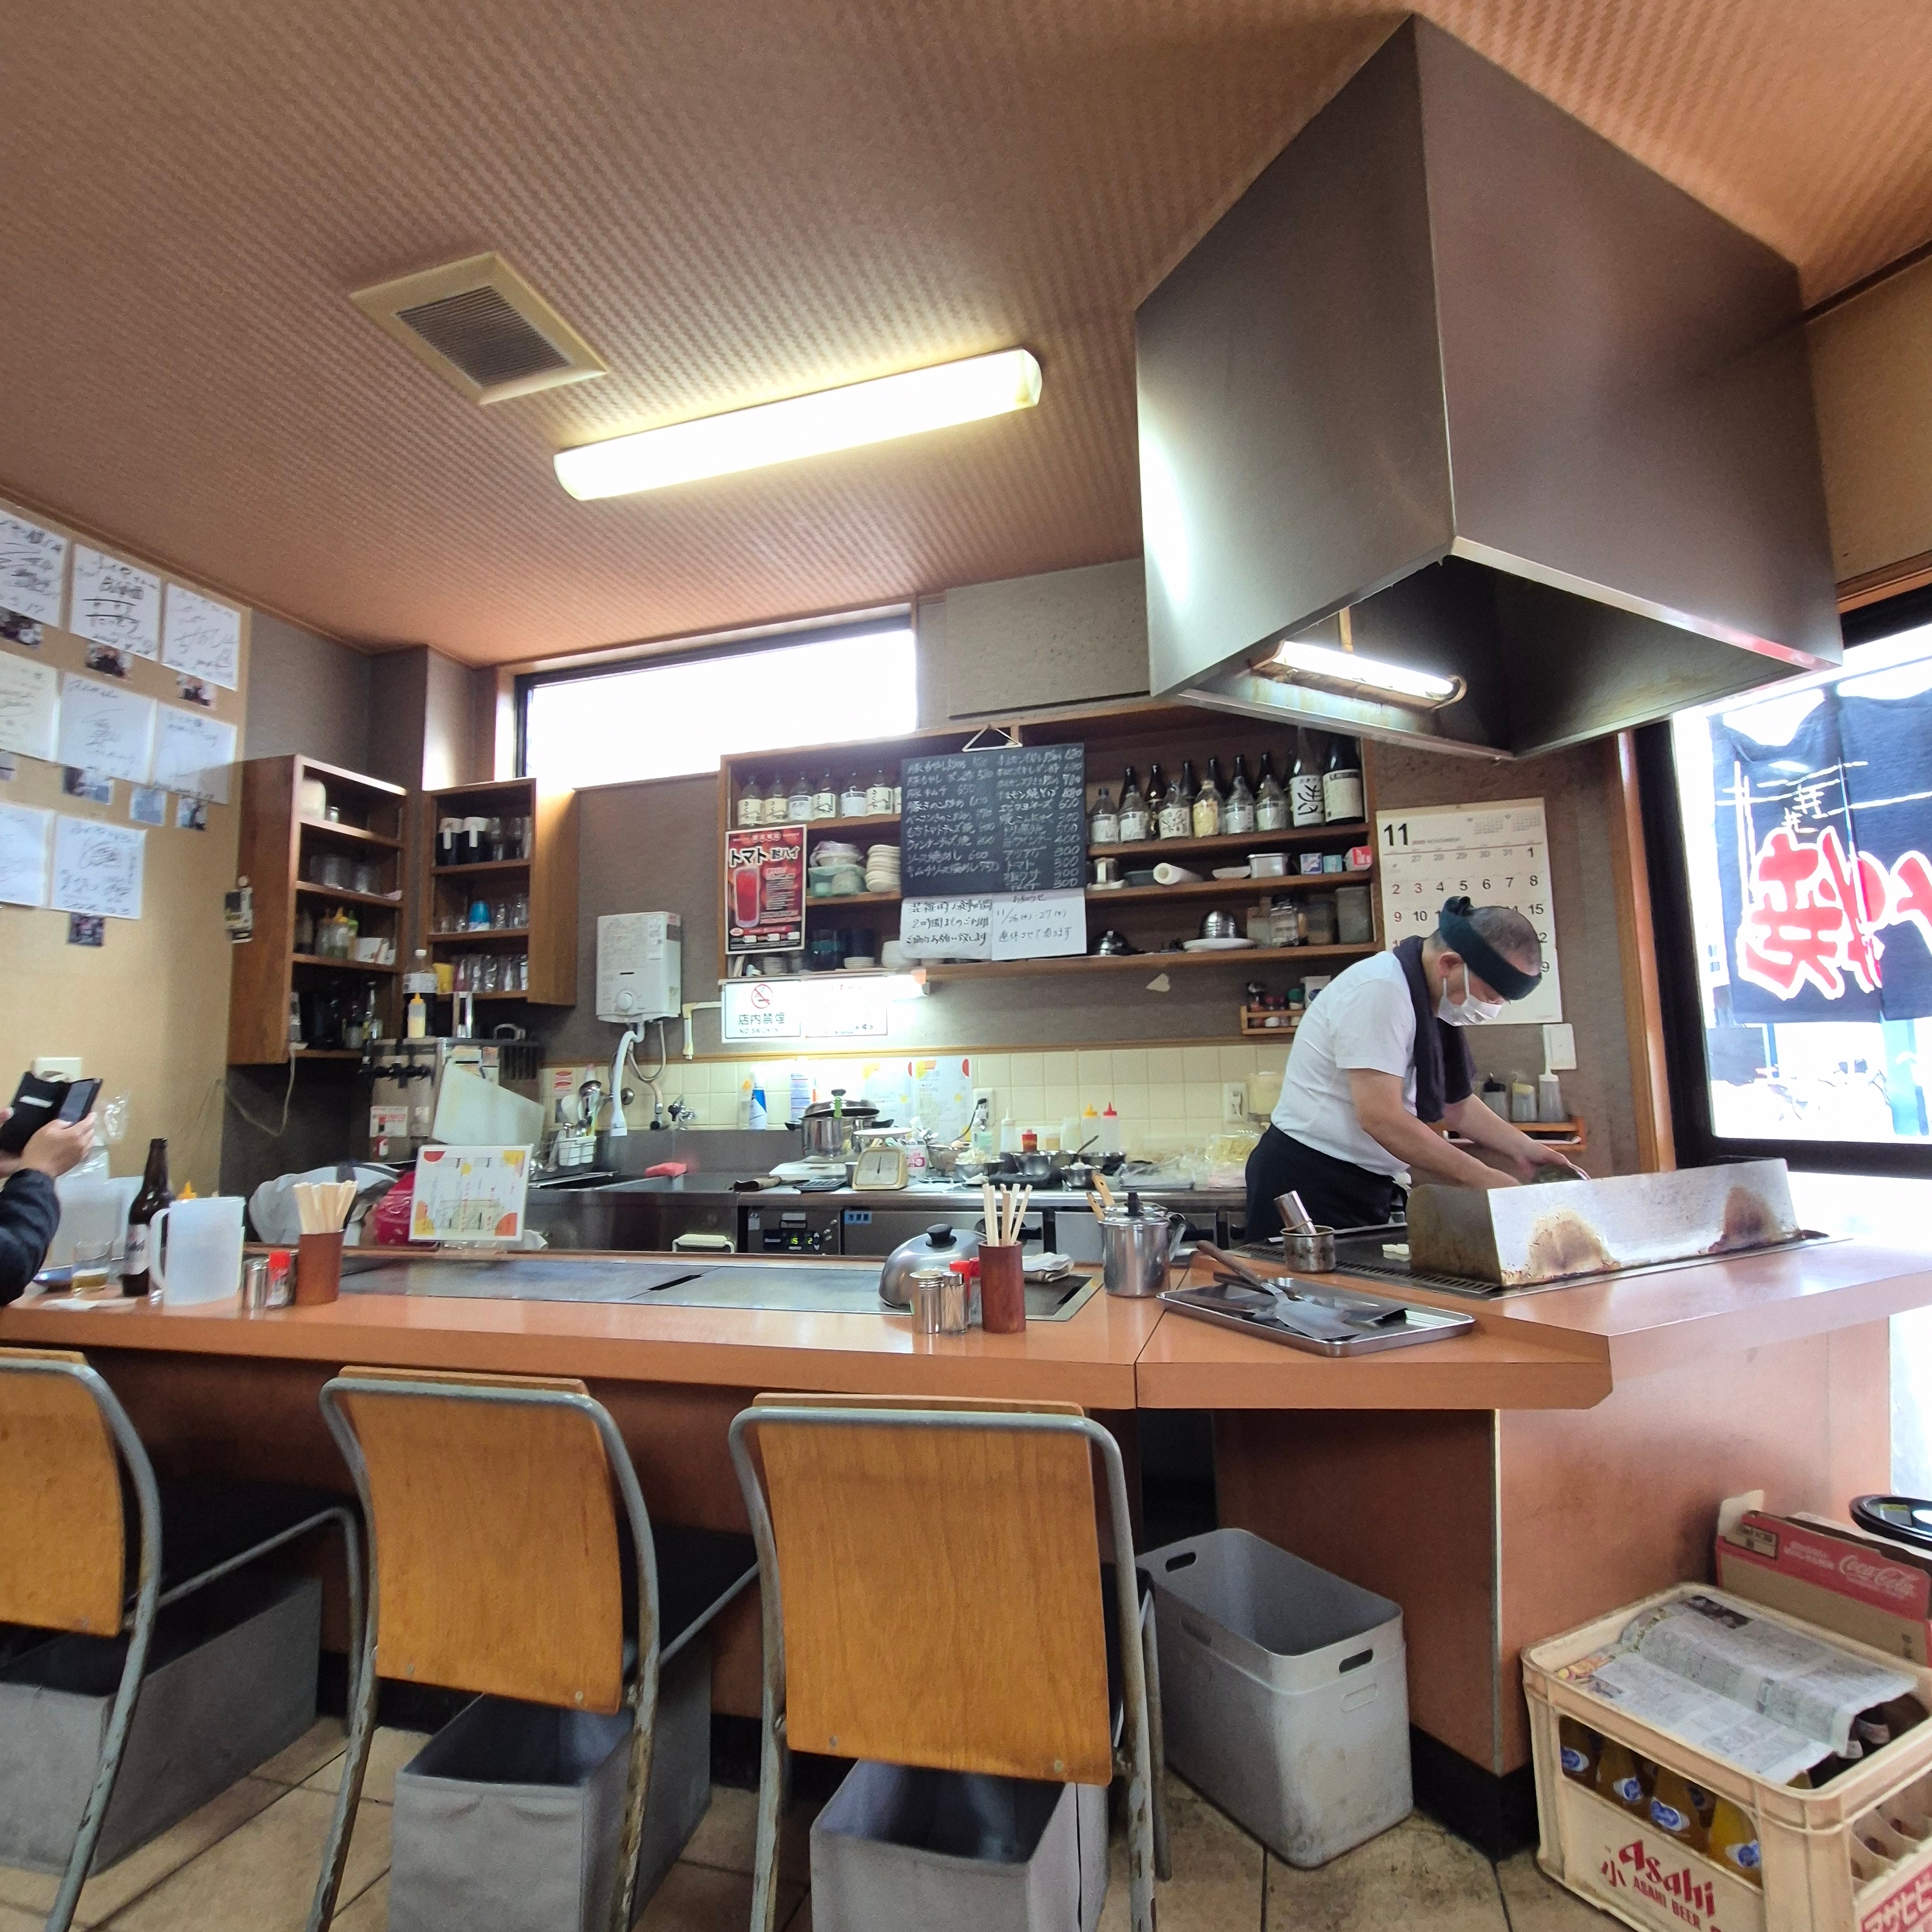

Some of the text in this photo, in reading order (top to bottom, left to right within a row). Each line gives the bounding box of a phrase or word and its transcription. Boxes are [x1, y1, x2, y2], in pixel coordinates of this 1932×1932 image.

[1384, 823, 1408, 846] 11
[1527, 847, 1533, 857] 1
[1392, 875, 1538, 894] 2 3 4 5 6 7 8
[1394, 912, 1402, 922] 9
[1413, 911, 1427, 922] 10
[1528, 904, 1544, 914] 15
[1539, 933, 1548, 943] 2
[1540, 961, 1549, 972] 9
[738, 1012, 784, 1025] 店内禁煙
[1601, 1859, 1627, 1888] 小
[1619, 1839, 1715, 1918] Asahi
[1634, 1875, 1701, 1931] ASAHI BEER
